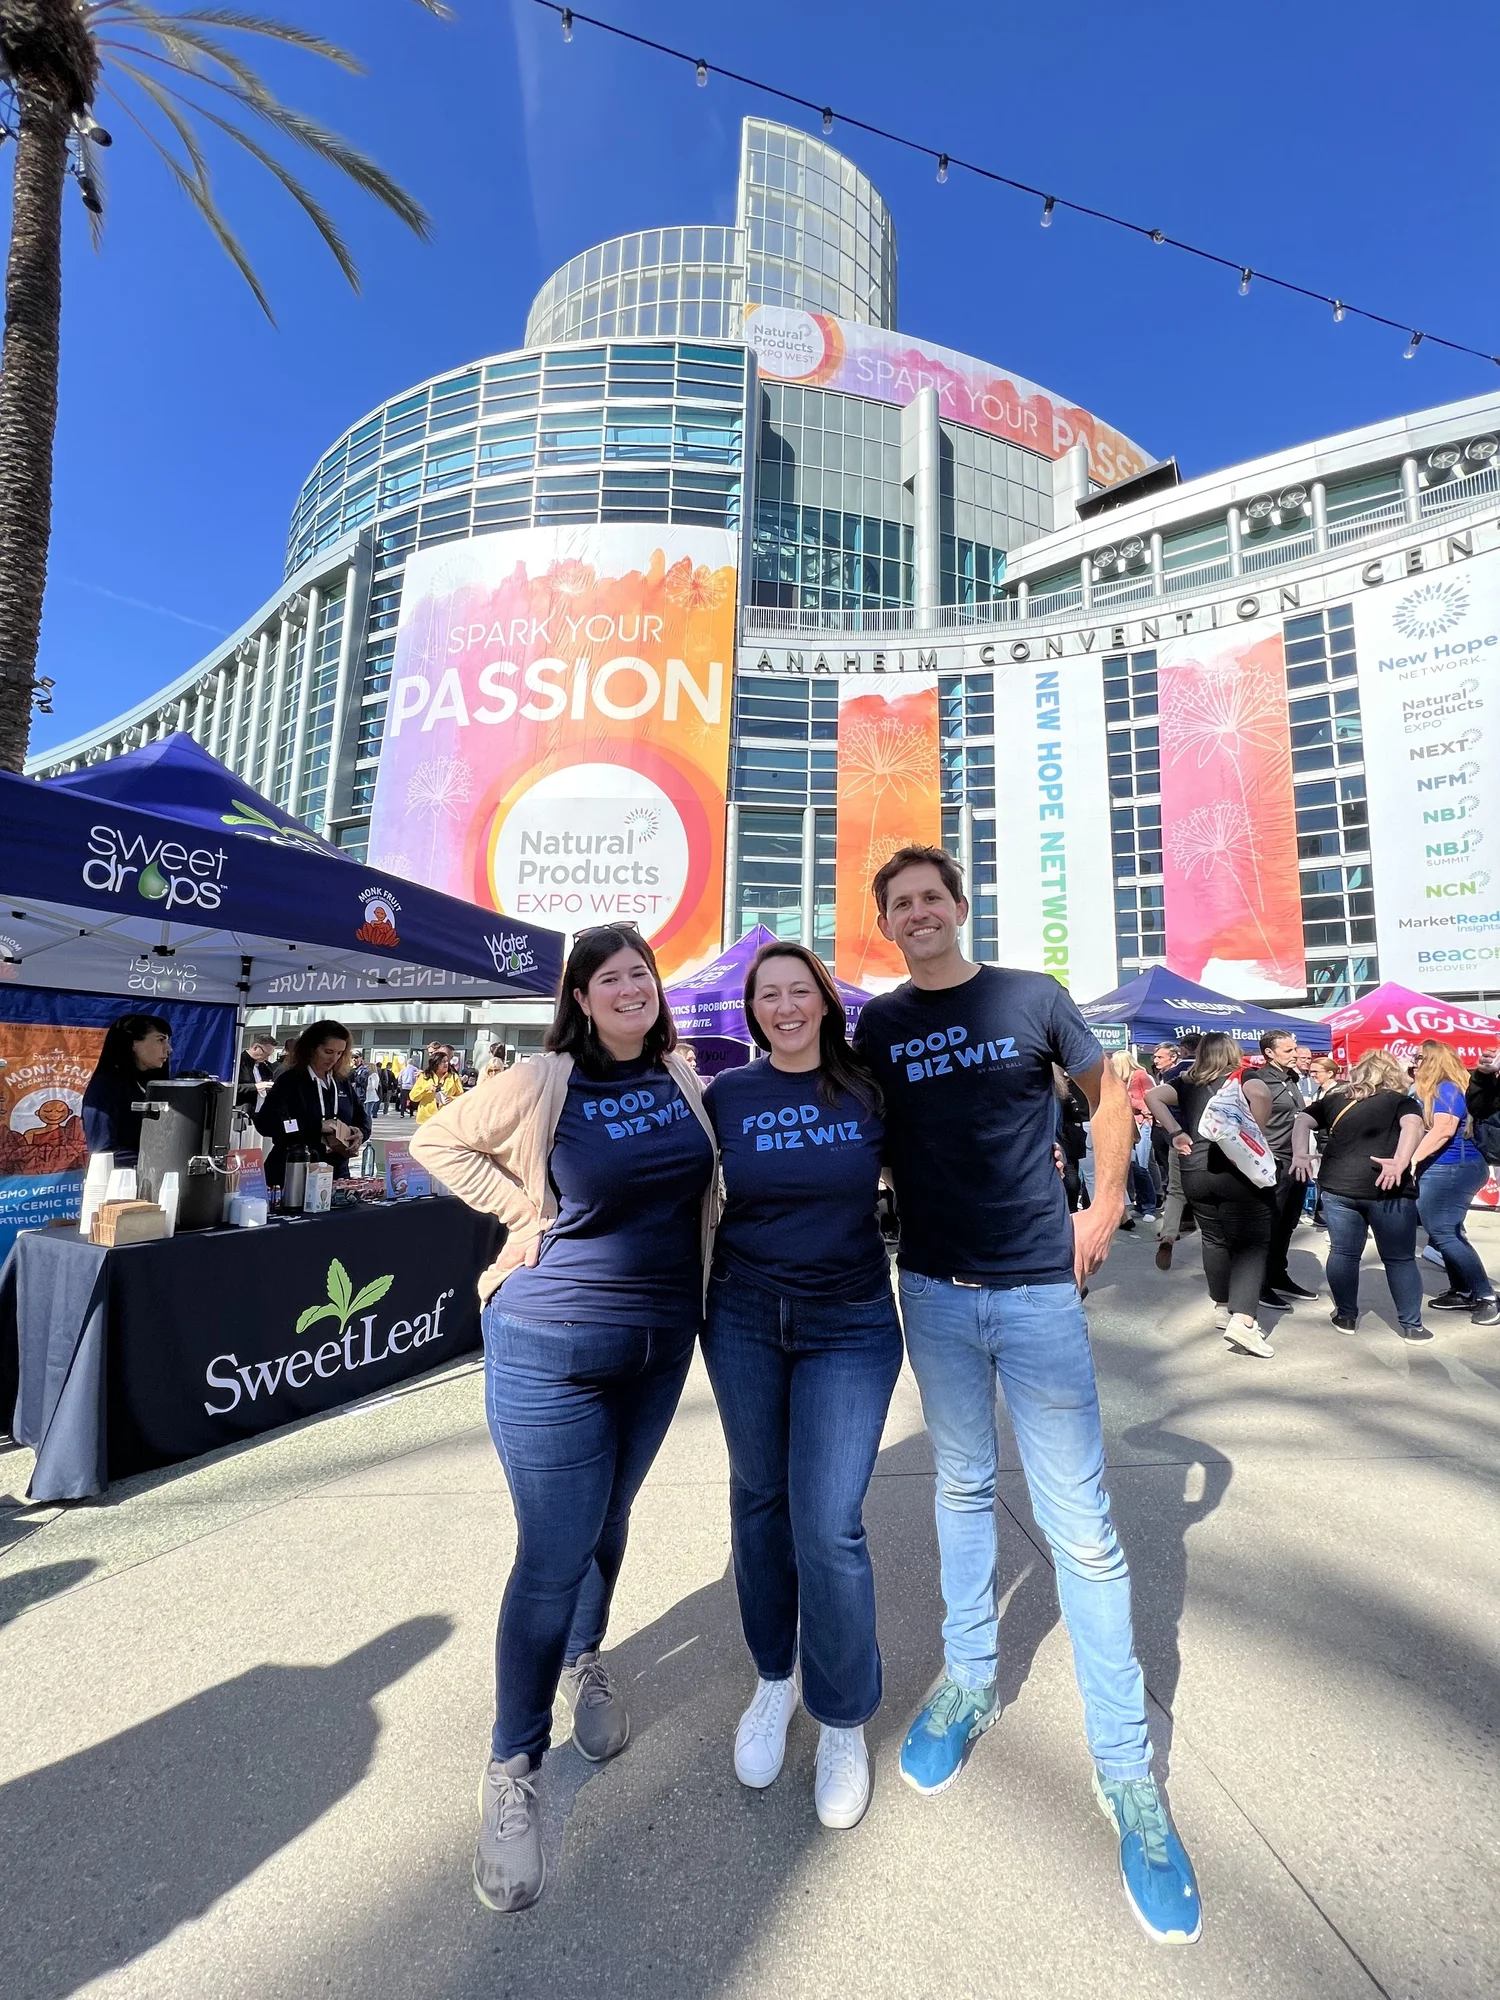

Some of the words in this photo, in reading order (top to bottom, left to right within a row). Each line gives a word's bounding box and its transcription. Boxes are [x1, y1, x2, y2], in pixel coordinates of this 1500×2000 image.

[753, 335, 813, 353] Products
[754, 324, 802, 341] Natural
[755, 347, 783, 359] EXPO
[785, 351, 814, 365] WEST
[964, 385, 1038, 437] YOUR
[1053, 414, 1140, 481] PASS
[757, 649, 938, 673] ANAHEIM
[979, 584, 1300, 666] CONVENTION
[1362, 520, 1500, 587] CEN
[448, 615, 554, 654] SPARK
[556, 613, 663, 645] YOUR
[1378, 651, 1427, 672] New
[1433, 635, 1498, 659] Hope
[1399, 655, 1480, 681] NETWORK
[389, 655, 723, 738] PASSION
[1036, 670, 1061, 731] NEW
[1402, 688, 1467, 711] Natural
[1403, 699, 1484, 722] Products
[1404, 719, 1442, 733] EXPO
[1410, 738, 1469, 761] NEXT
[1037, 742, 1065, 821] HOPE
[1417, 772, 1466, 792] NFM
[1423, 806, 1466, 824] NBJ
[88, 826, 228, 879] sweet
[520, 829, 634, 855] Natural
[1426, 840, 1469, 857] NBJ
[518, 859, 660, 886] Products
[1426, 856, 1470, 867] SUMMIT
[82, 855, 222, 910] drops
[1426, 881, 1476, 898] NCN
[358, 886, 382, 903] MONK
[383, 890, 402, 912] FRUIT
[516, 893, 583, 913] EXPO
[590, 894, 663, 914] WEST
[1040, 832, 1070, 988] NETWORK
[1457, 922, 1500, 933] Insights
[483, 932, 529, 953] Water
[493, 951, 535, 974] Drops
[1418, 963, 1478, 973] DISCOVERY
[691, 1003, 697, 1013] &
[698, 999, 745, 1013] PROBIOTICS
[1163, 998, 1246, 1015] Lifeway
[693, 1018, 712, 1028] BITE.
[1380, 1006, 1500, 1034] Nixie
[890, 1025, 967, 1063] FOOD
[906, 1053, 953, 1082] BIZ
[953, 1036, 1020, 1068] WIZ
[4, 1063, 57, 1086] MONK
[17, 1075, 51, 1090] ORGANIC
[583, 1090, 655, 1120] FOOD
[604, 1116, 651, 1139] BIZ
[648, 1099, 690, 1127] WIZ
[742, 1104, 819, 1134] FOOD
[756, 1130, 804, 1151] BIZ
[805, 1121, 862, 1145] WIZ
[204, 1290, 449, 1416] SweetLeaf
